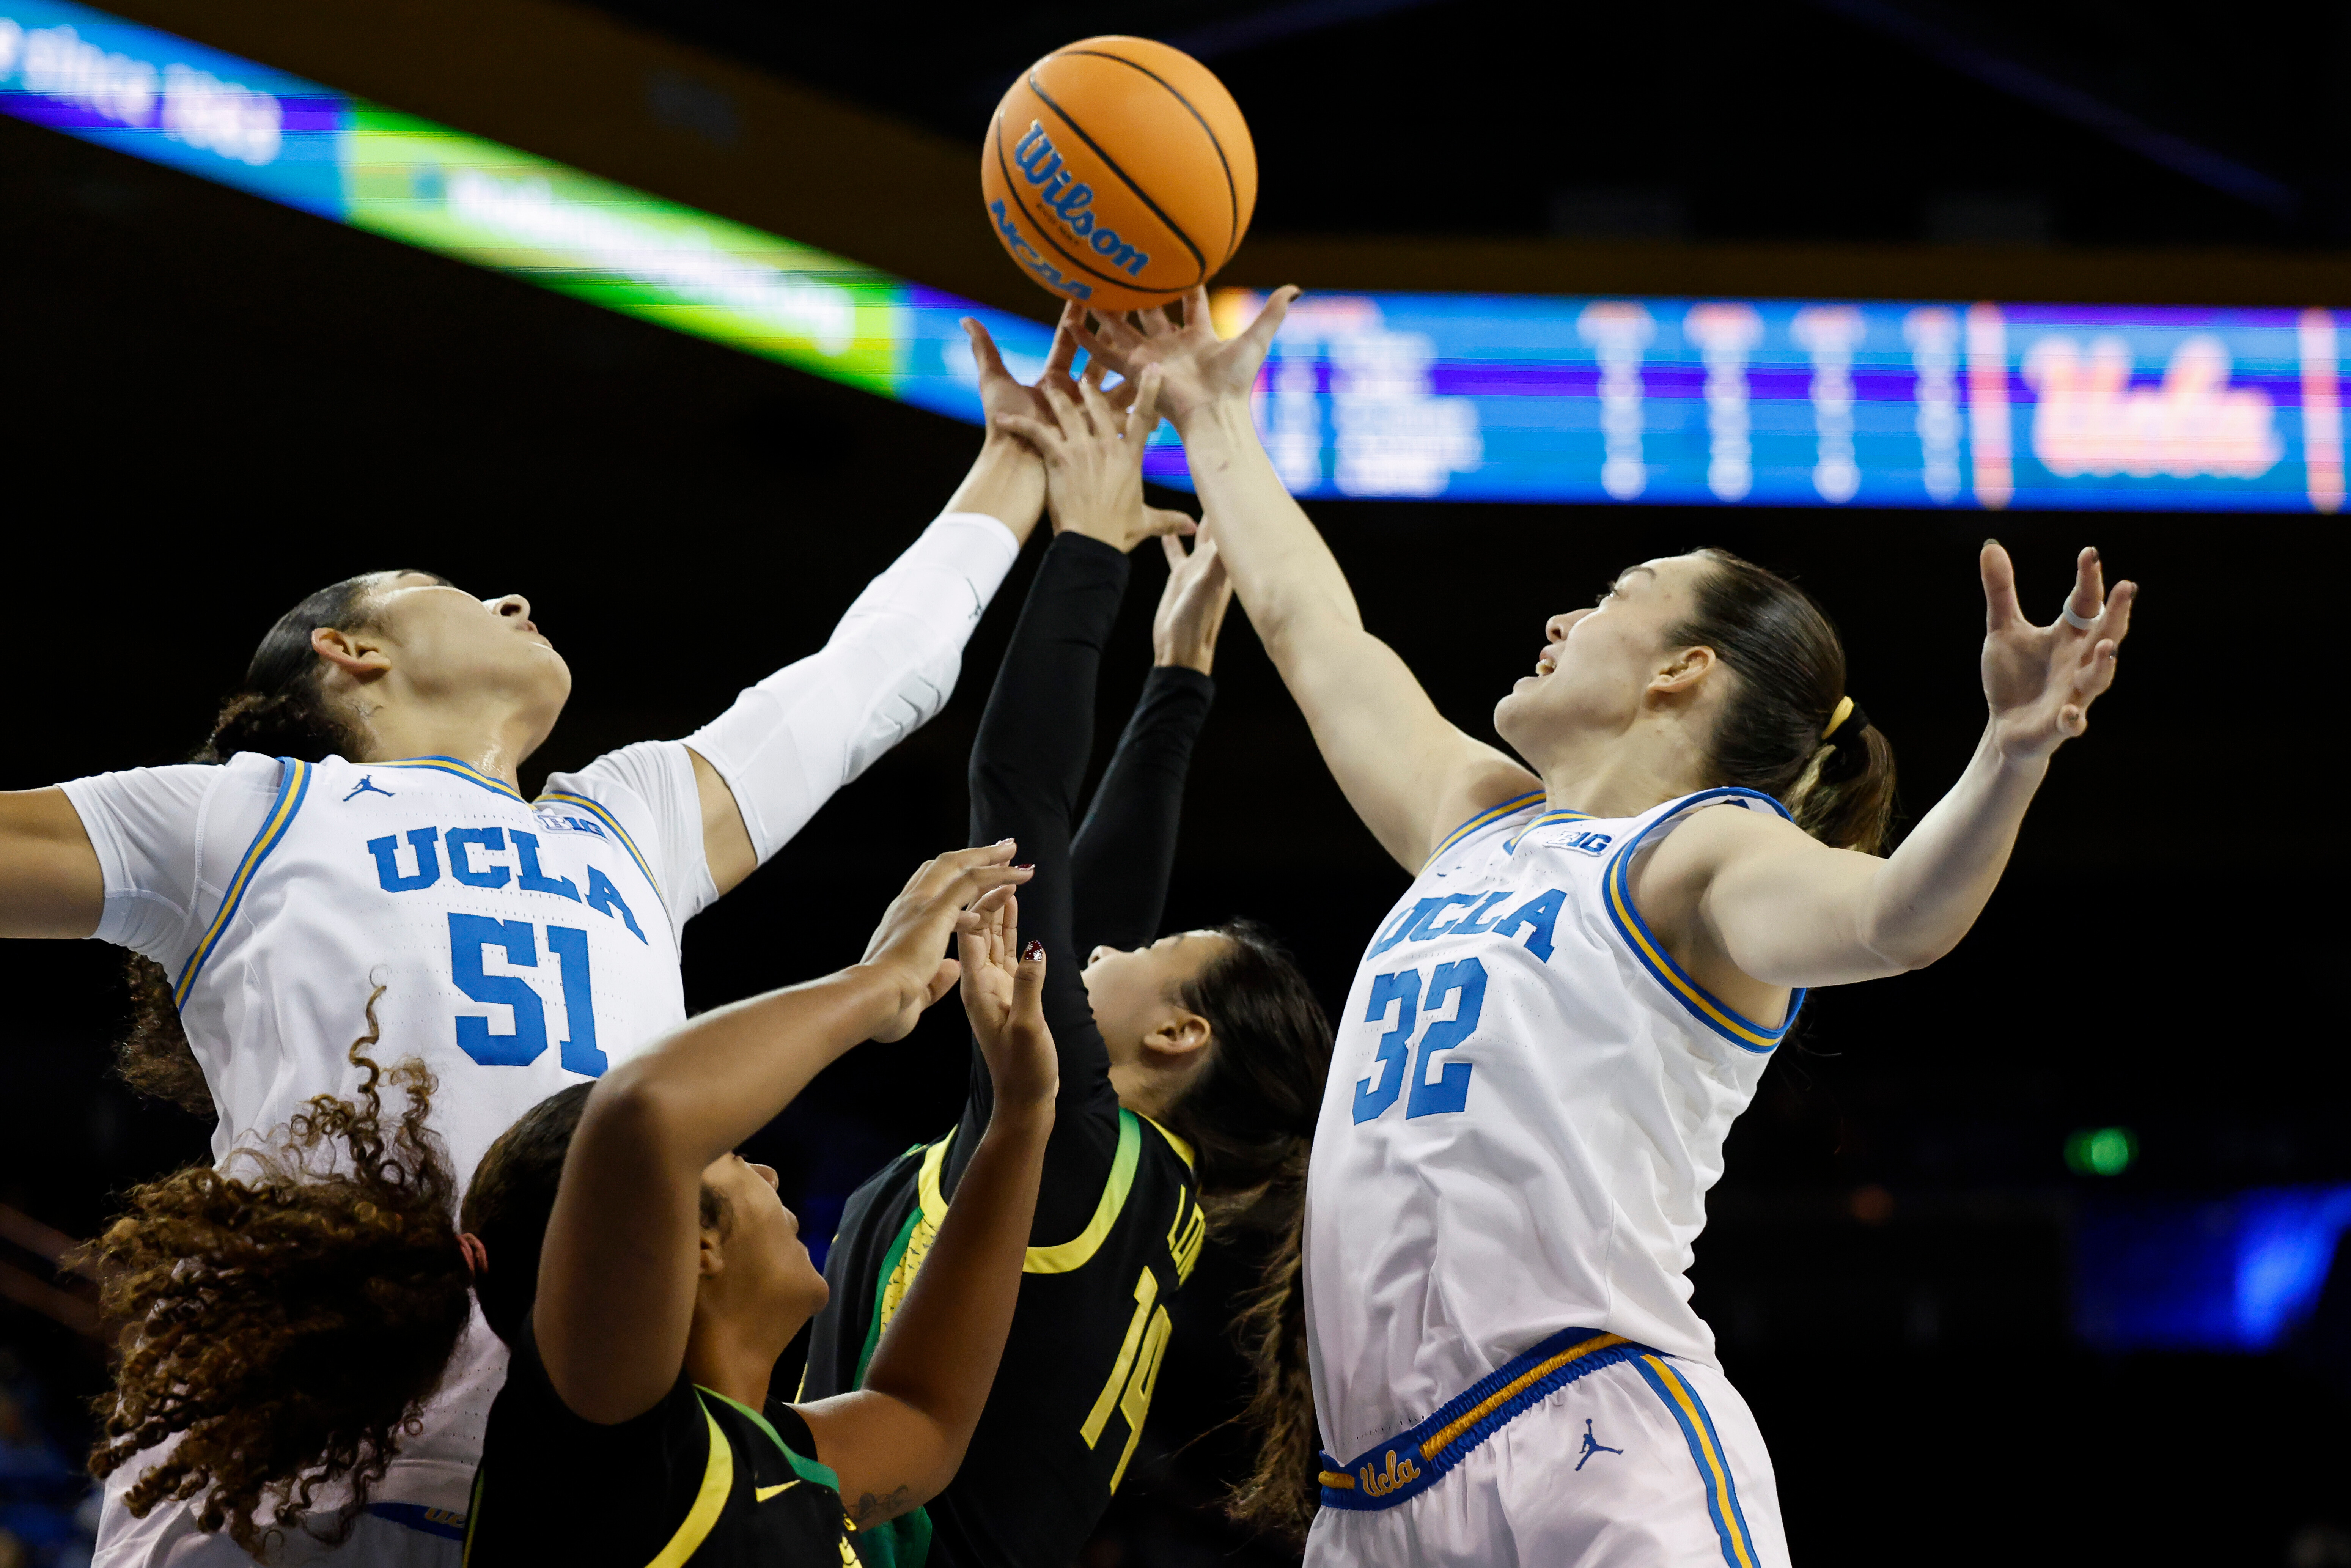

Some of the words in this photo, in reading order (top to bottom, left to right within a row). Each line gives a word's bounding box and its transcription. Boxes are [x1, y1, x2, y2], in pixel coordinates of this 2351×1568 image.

[991, 198, 1093, 301] NCAA
[1014, 120, 1150, 277] Wilson
[367, 826, 649, 946] UCLA
[1366, 888, 1568, 964] UCLA
[447, 912, 608, 1078] 51
[1352, 956, 1488, 1126] 32
[1360, 1450, 1420, 1497] Ucla
